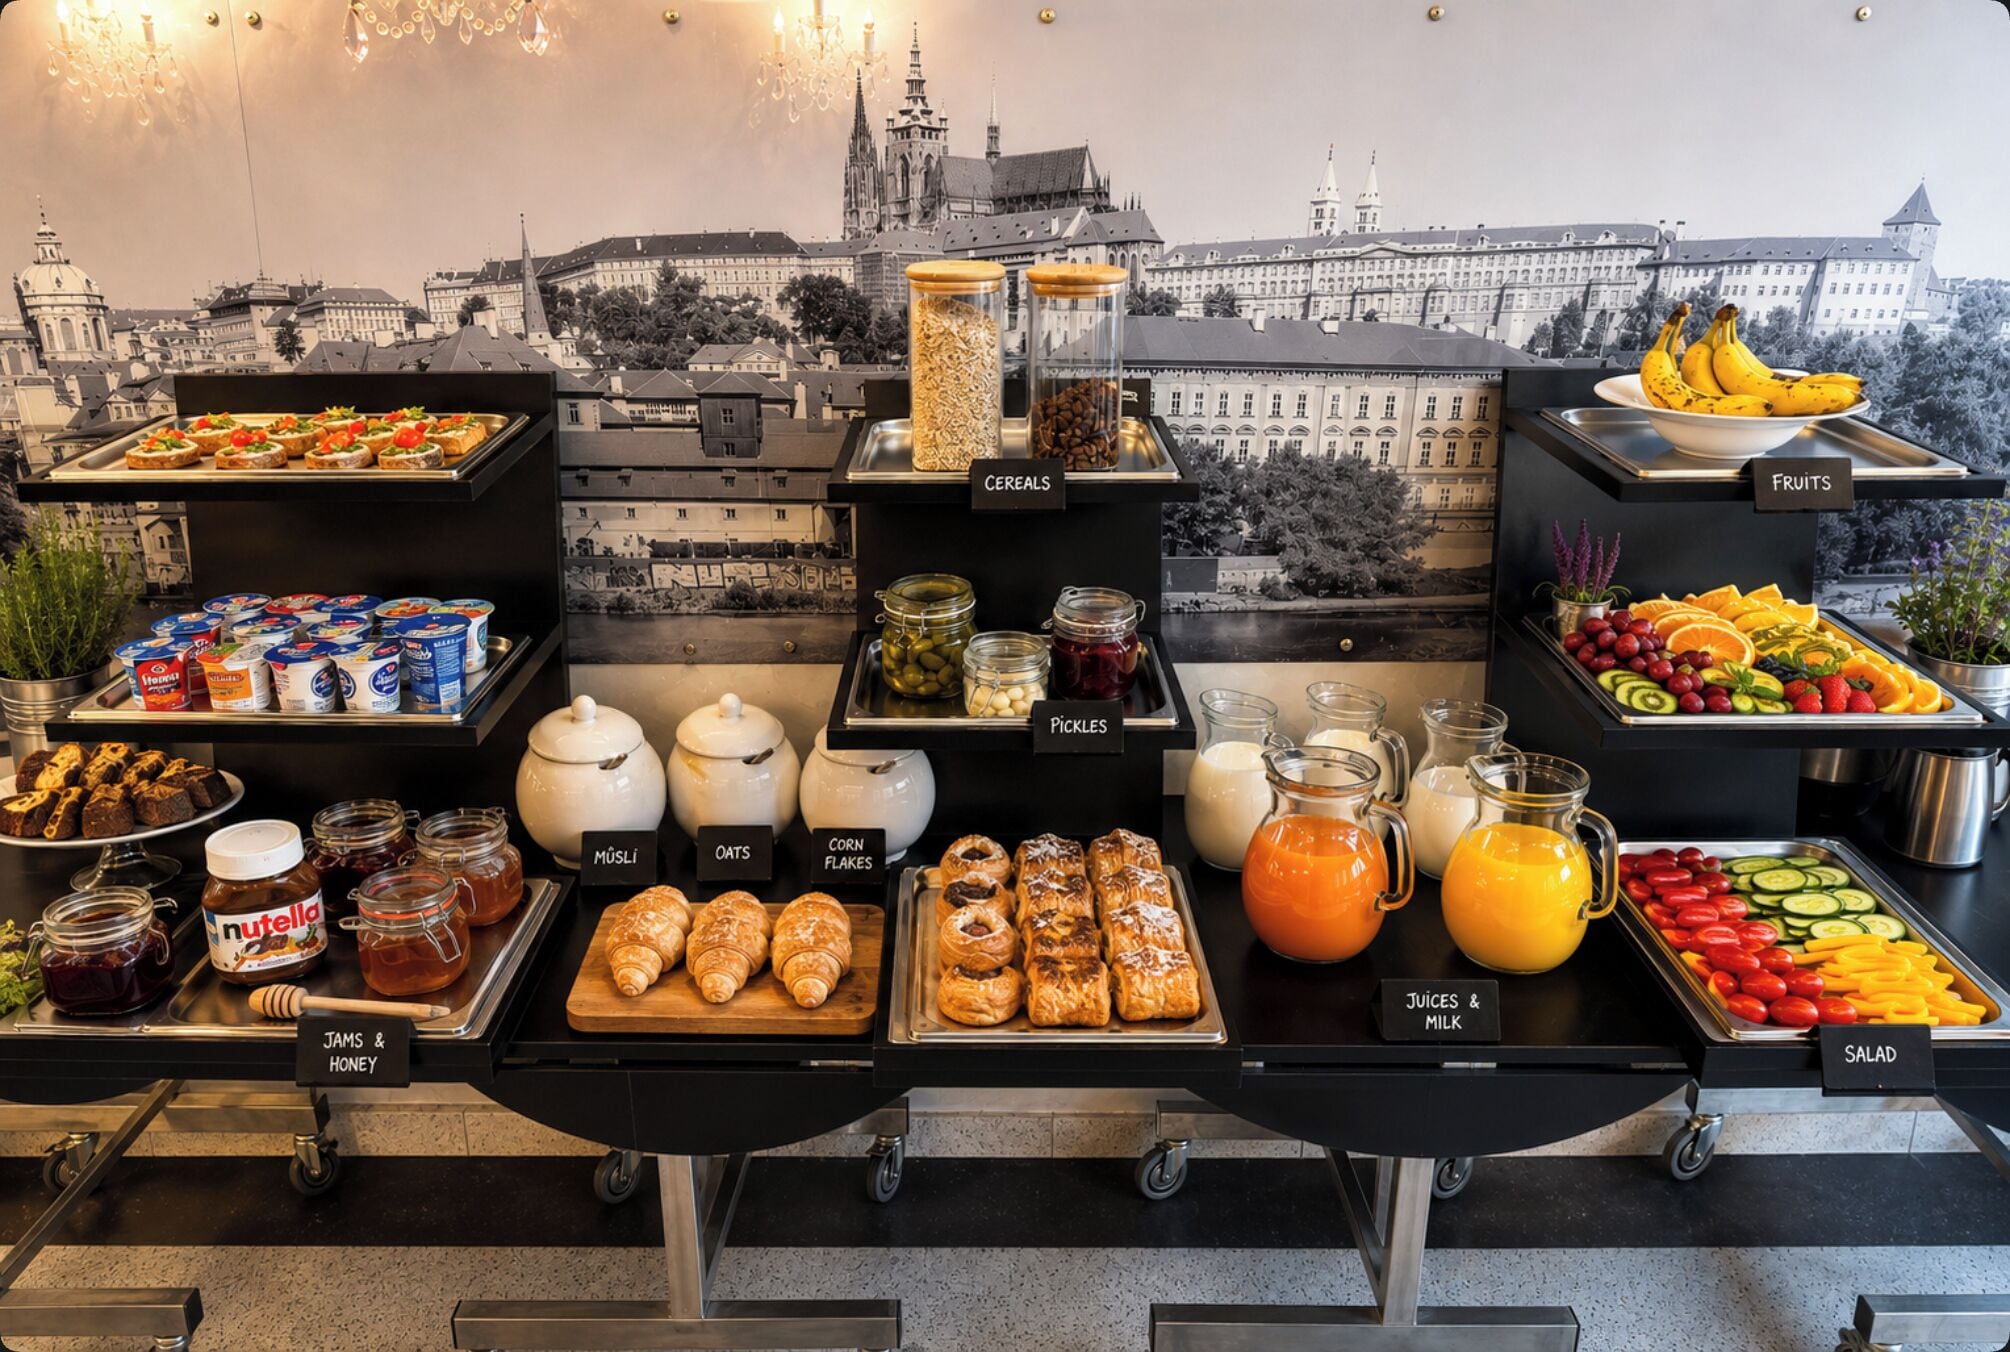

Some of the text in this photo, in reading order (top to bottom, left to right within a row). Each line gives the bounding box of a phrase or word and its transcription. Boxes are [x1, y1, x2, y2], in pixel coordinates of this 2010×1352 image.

[984, 474, 1051, 491] CEREALS
[715, 845, 751, 860] OATS
[828, 837, 865, 852] CORN
[824, 855, 873, 870] FLAKES
[222, 901, 320, 940] nutella
[1469, 993, 1480, 1010] &
[1425, 1014, 1463, 1030] MILK
[322, 1031, 385, 1049] JAMS &
[1844, 1044, 1897, 1063] SALAD
[329, 1055, 378, 1074] HONEY
